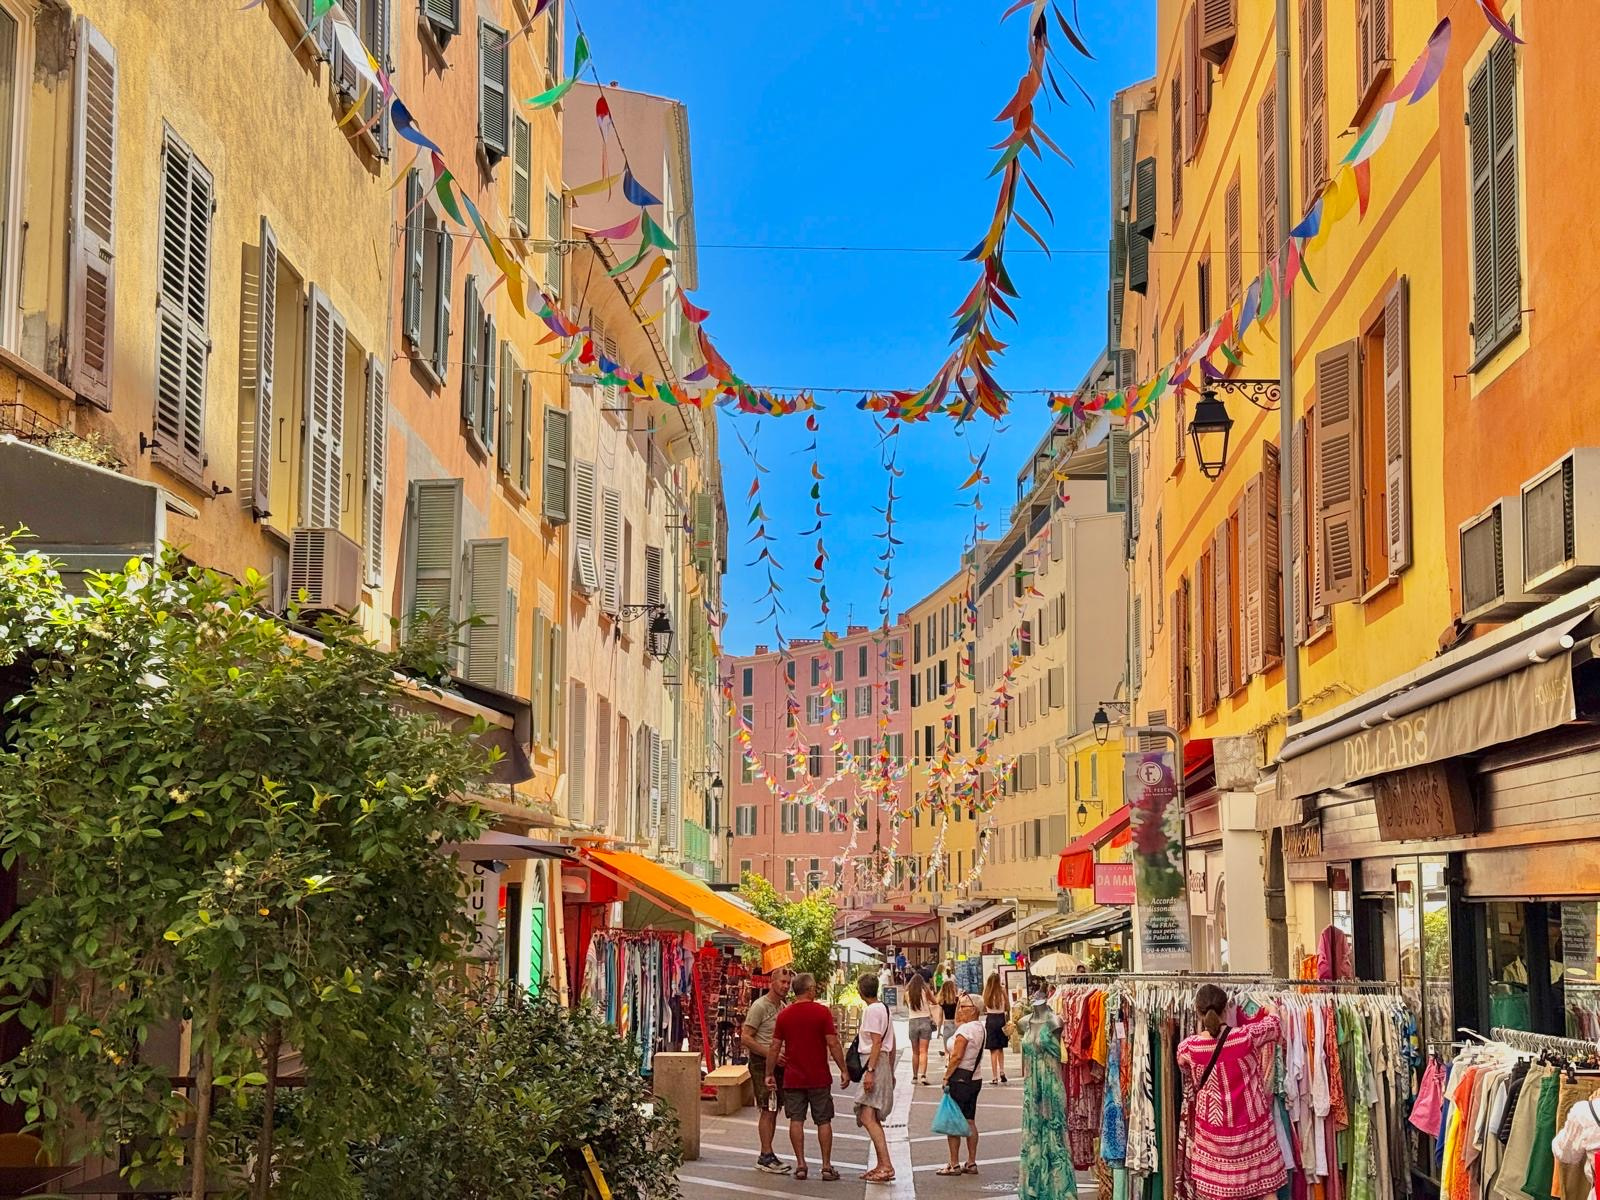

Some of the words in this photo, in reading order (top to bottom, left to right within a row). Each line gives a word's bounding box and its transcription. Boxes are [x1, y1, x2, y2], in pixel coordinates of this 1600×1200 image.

[1344, 714, 1428, 779] DOLLARS
[1097, 874, 1111, 886] DA
[1151, 896, 1177, 905] Accords
